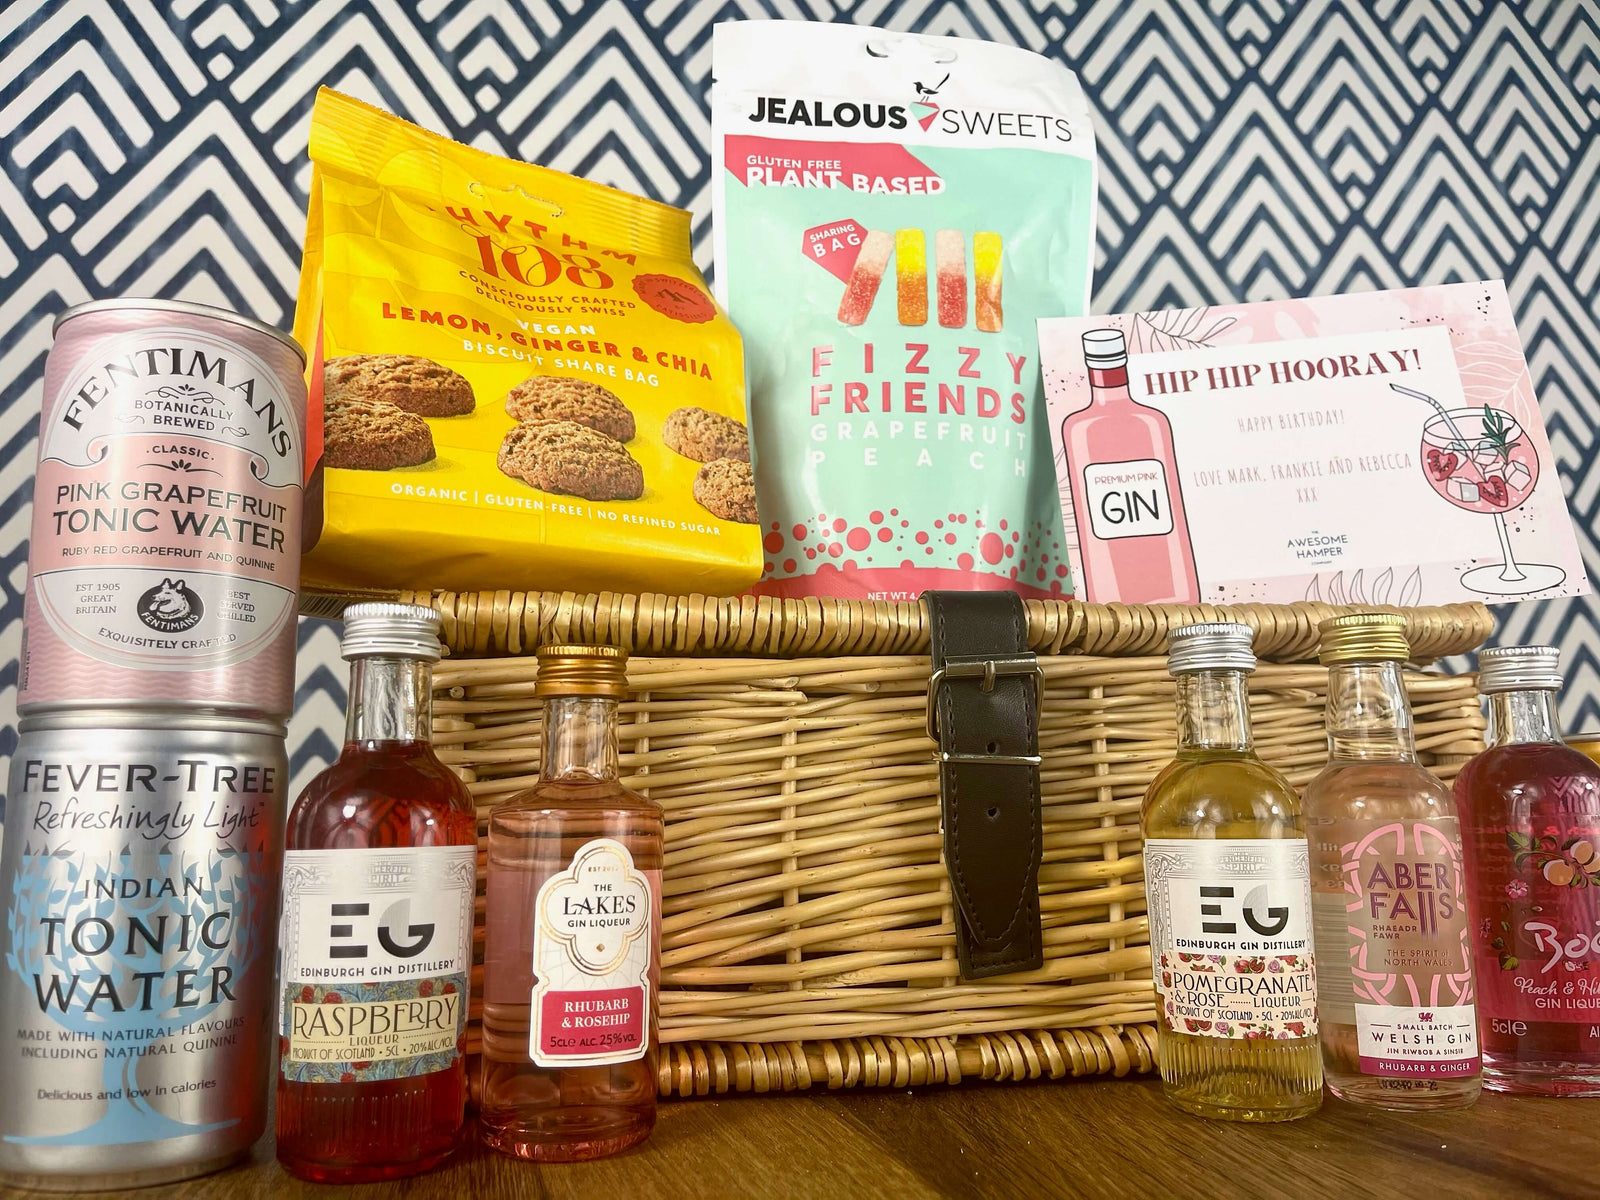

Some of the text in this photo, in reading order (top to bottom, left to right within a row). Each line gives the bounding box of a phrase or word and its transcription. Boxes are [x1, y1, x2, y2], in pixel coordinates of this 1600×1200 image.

[748, 97, 1072, 142] JEALOUS SWEETS
[746, 154, 841, 170] GLUTEN FREE
[746, 167, 946, 195] PLANT BASED
[810, 224, 855, 243] SHARING
[812, 233, 861, 258] BAG
[460, 224, 614, 289] 108
[459, 269, 563, 304] CONSCIOUSLY
[571, 296, 636, 310] CRAFTED
[476, 286, 626, 317] DELICIOUSLY SWISS
[517, 319, 596, 336] VEGAN
[382, 302, 713, 381] LEMON, GINGER & CHIA
[463, 340, 660, 387] BISCUIT SHARE BAG
[812, 343, 1027, 385] FIZZY
[1144, 348, 1422, 396] HIP HIP HOORAY!
[63, 347, 291, 458] FENTIMANS
[134, 400, 234, 421] BOTANICALLY
[811, 381, 1026, 424] FRIENDS
[153, 414, 215, 431] BREWED
[1238, 408, 1345, 433] HAPPY BIRTHDAY!
[810, 420, 1026, 451] GRAPEFRUIT
[811, 447, 1026, 477] PEACH
[1193, 469, 1224, 488] LOVE
[1228, 466, 1268, 482] MARK,
[1271, 461, 1323, 480] FRANKIE
[1359, 453, 1412, 473] REBECCA
[1094, 472, 1158, 485] PREMIUM PINK
[57, 481, 287, 523] PINK GRAPEFRUIT
[1297, 487, 1318, 503] XXX
[391, 482, 721, 536] ORGANIC GLUTEN-FREE NO REFINED SUGAR
[1101, 489, 1159, 524] GIN
[52, 508, 285, 554] TONIC WATER
[1287, 534, 1349, 548] AWESOME
[62, 545, 275, 571] RUBY RED GRAPEFRUIT AND QUININE
[1297, 547, 1343, 559] HAMPER
[76, 582, 121, 592] EST 1905
[228, 589, 250, 601] BEST
[867, 592, 889, 601] NET
[890, 591, 907, 601] WT
[80, 594, 113, 603] GREAT
[76, 605, 117, 615] BRITAIN
[140, 609, 200, 631] FENTIMANS
[99, 627, 178, 649] EXQUISITELY
[23, 760, 276, 794] FEVER-TREE
[33, 797, 260, 840] Refreshingly Light
[1367, 862, 1452, 890] ABER
[84, 876, 204, 900] INDIAN
[593, 884, 612, 892] THE
[562, 894, 636, 915] LAKES
[1199, 883, 1289, 937] EG
[329, 898, 436, 959] EG
[567, 918, 631, 928] GIN LIQUEUR
[1372, 924, 1417, 932] RHAEADR
[40, 911, 231, 957] TONIC
[1176, 938, 1306, 951] EDINBURGH GIN DISTILLERY
[1373, 932, 1400, 940] FAWR
[1384, 959, 1453, 967] NORTH WALES
[1387, 949, 1405, 957] THE
[1410, 949, 1438, 957] SPIRIT
[300, 959, 455, 978] EDINBURGH GIN DISTILLERY
[33, 966, 238, 1014] WATER
[1173, 971, 1313, 997] POMEGRANATE
[1513, 976, 1558, 995] Peach
[1562, 981, 1575, 995] &
[564, 998, 629, 1013] RHUBARB
[1174, 989, 1301, 1008] & ROSE LIQUEUR
[1535, 997, 1561, 1009] GIN
[292, 995, 458, 1040] RASPBERRY
[561, 1012, 631, 1028] & ROSEHIP
[1175, 1004, 1201, 1018] PRODUCT
[1202, 1007, 1215, 1019] OF
[1218, 1010, 1253, 1021] SCOTLAND
[1261, 1011, 1273, 1021] 5CL
[17, 1016, 245, 1042] MADE WITH NATURAL FLAVOURS
[1397, 1023, 1453, 1031] SMALL BATCH
[21, 1034, 238, 1059] INCLUDING NATURAL QUININE
[349, 1034, 400, 1047] LIQUEUR
[600, 1032, 623, 1046] 25%
[1371, 1031, 1471, 1045] WELSH GIN
[292, 1047, 318, 1060] PRODUCT
[319, 1048, 332, 1060] OF
[335, 1047, 376, 1060] SCOTLAND
[386, 1045, 399, 1057] 5CL
[1402, 1048, 1434, 1056] RIWBOB
[1379, 1062, 1426, 1072] RHUBARB
[1440, 1062, 1471, 1072] GINGER
[37, 1088, 93, 1101] Delicious
[97, 1088, 121, 1100] and
[126, 1087, 151, 1099] low
[171, 1079, 217, 1095] calories
